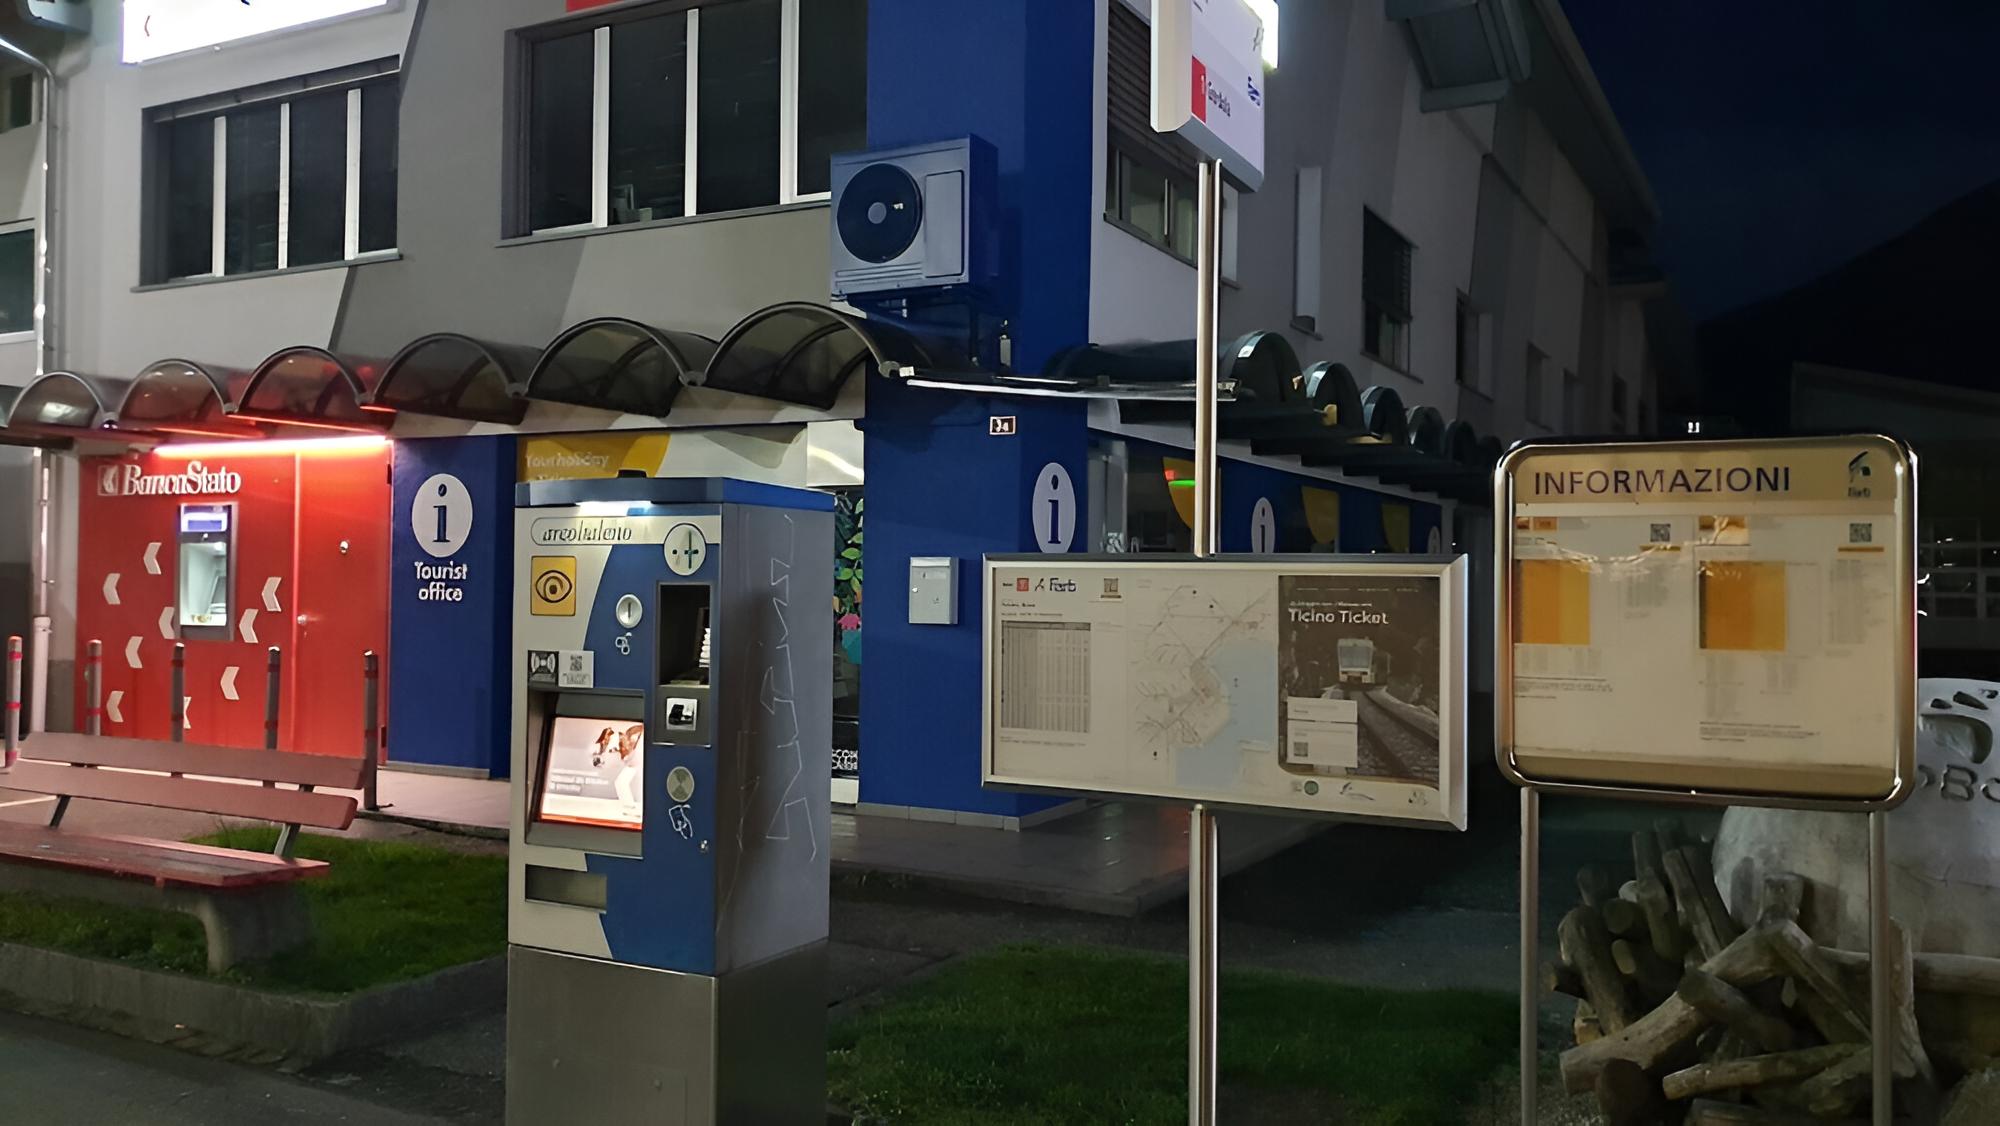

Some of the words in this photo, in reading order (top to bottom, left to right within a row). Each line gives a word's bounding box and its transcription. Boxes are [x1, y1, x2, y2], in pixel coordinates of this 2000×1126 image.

[123, 460, 242, 496] BancaStato
[1534, 466, 1791, 495] INFORMAZIONI
[414, 561, 468, 580] Tourist
[418, 581, 463, 601] office
[1288, 607, 1335, 623] Ticino
[1338, 610, 1390, 624] Ticket
